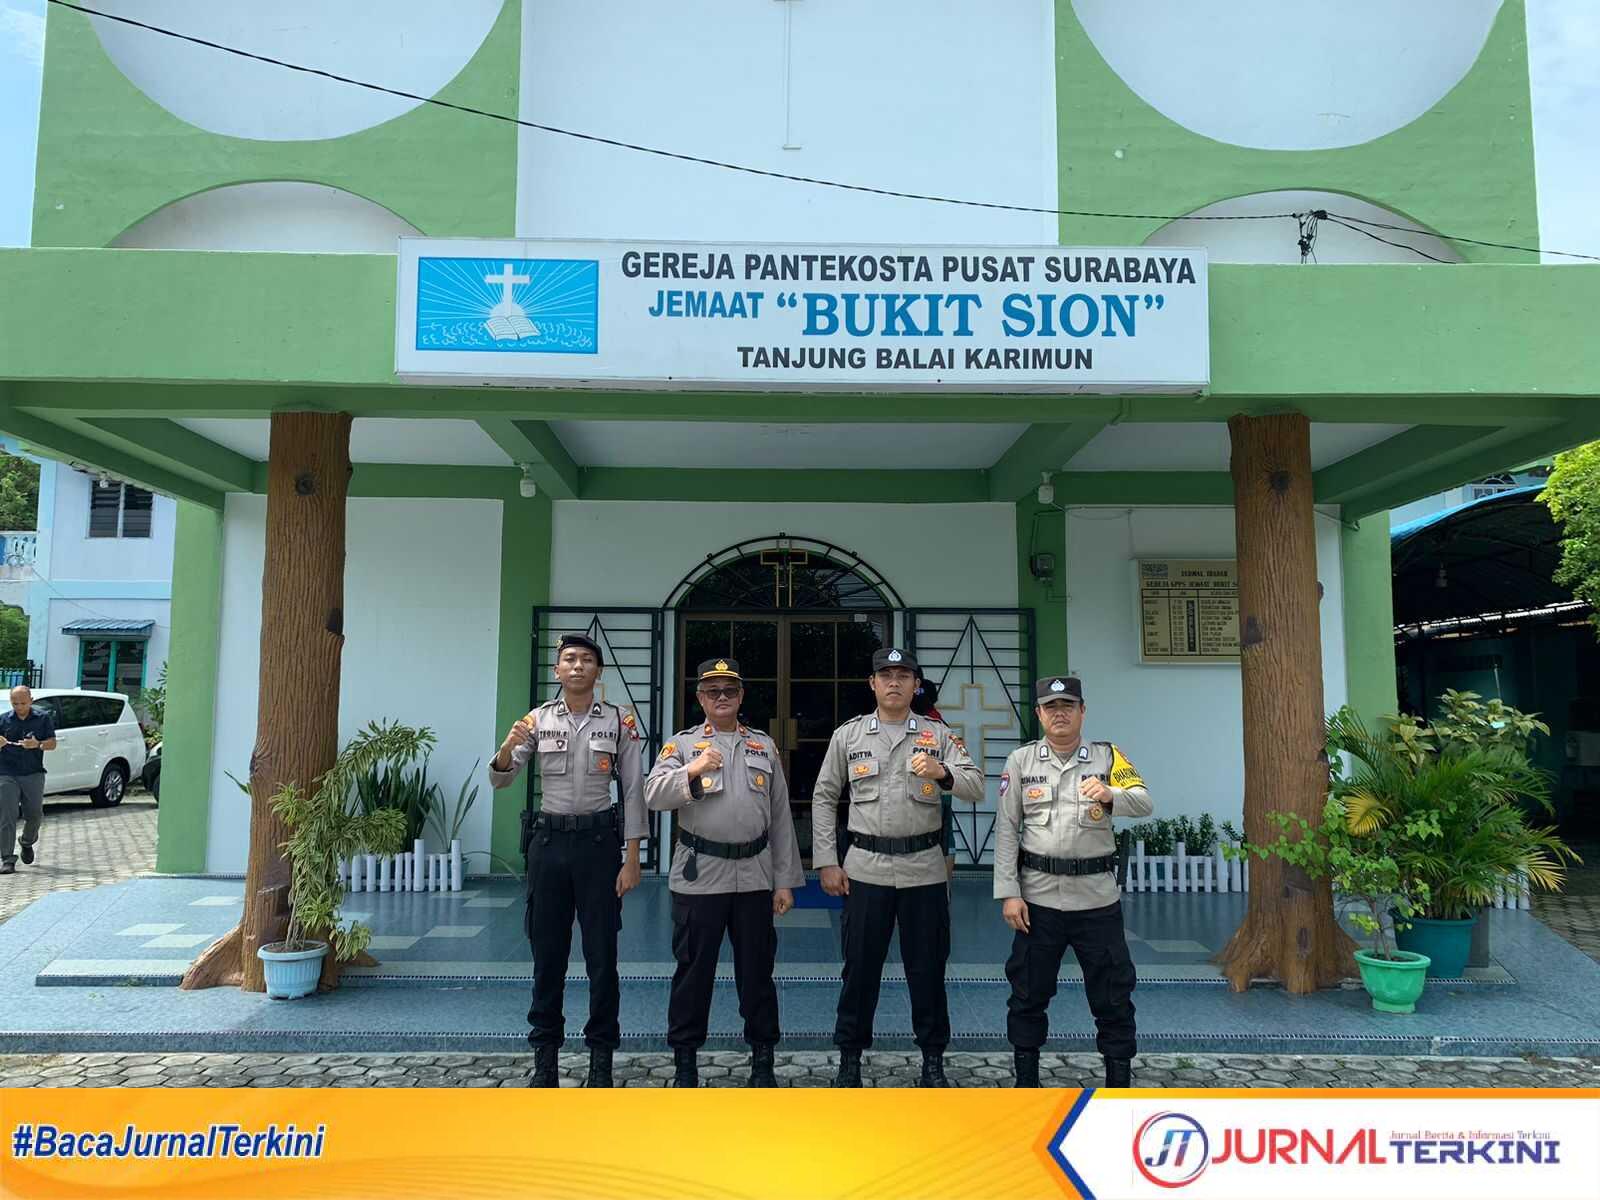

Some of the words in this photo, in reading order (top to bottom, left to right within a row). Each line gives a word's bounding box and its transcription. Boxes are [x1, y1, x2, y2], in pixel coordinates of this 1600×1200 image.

[622, 251, 735, 280] GEREJA
[745, 254, 933, 282] PANTEKOSTA
[943, 256, 1035, 283] PUSAT
[1045, 257, 1196, 284] SURABAYA
[648, 290, 764, 319] JEMAAT
[737, 346, 866, 369] TANJUNG
[876, 347, 954, 369] BALAI
[965, 348, 1093, 370] KARIMUN
[745, 749, 768, 758] POLRI
[849, 751, 872, 760] ADITYA
